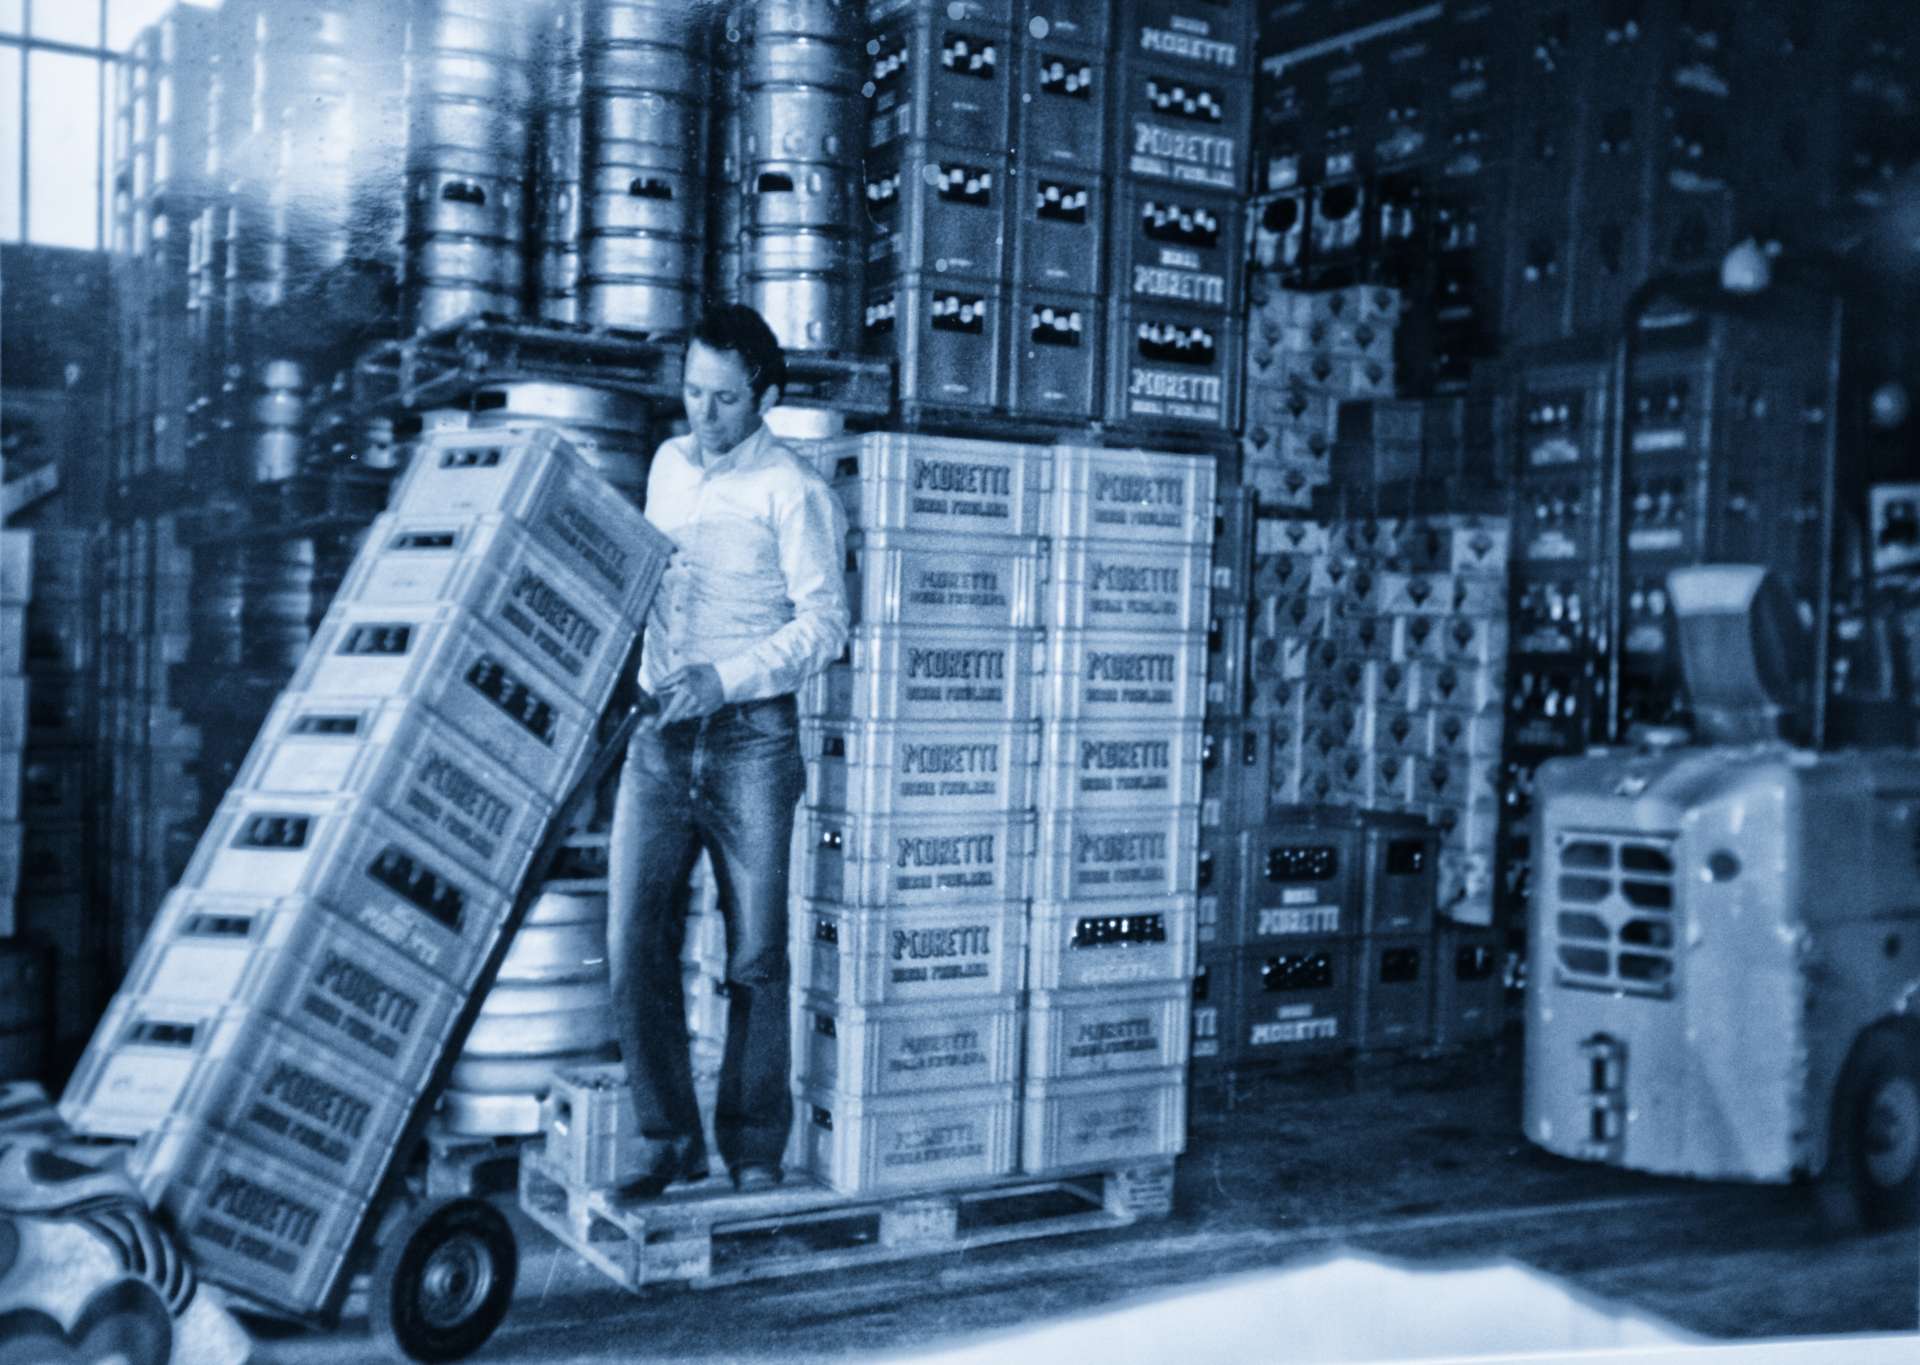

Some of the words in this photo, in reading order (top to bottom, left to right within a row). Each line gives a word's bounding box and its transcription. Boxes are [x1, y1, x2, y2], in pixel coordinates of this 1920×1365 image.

[1135, 122, 1233, 168] MORETTI
[1134, 265, 1224, 304] MORETTI
[1129, 368, 1220, 402] MORETTI
[913, 459, 1010, 496] MORETTI
[1095, 472, 1183, 506] MORETTI
[1090, 564, 1179, 593] MORETTI
[512, 564, 600, 657] MORETTI
[907, 649, 1004, 680] MORETTI
[1087, 652, 1174, 682] MORETTI
[902, 743, 998, 774] MORETTI
[1081, 740, 1169, 770] MORETTI
[418, 751, 513, 836] MORETTI
[898, 834, 994, 868] MORETTI
[1077, 832, 1166, 863] MORETTI
[891, 926, 990, 960] MORETTI
[314, 951, 419, 1035] MORETTI
[261, 1061, 371, 1139] MORETTI
[207, 1168, 320, 1248] MORETTI
